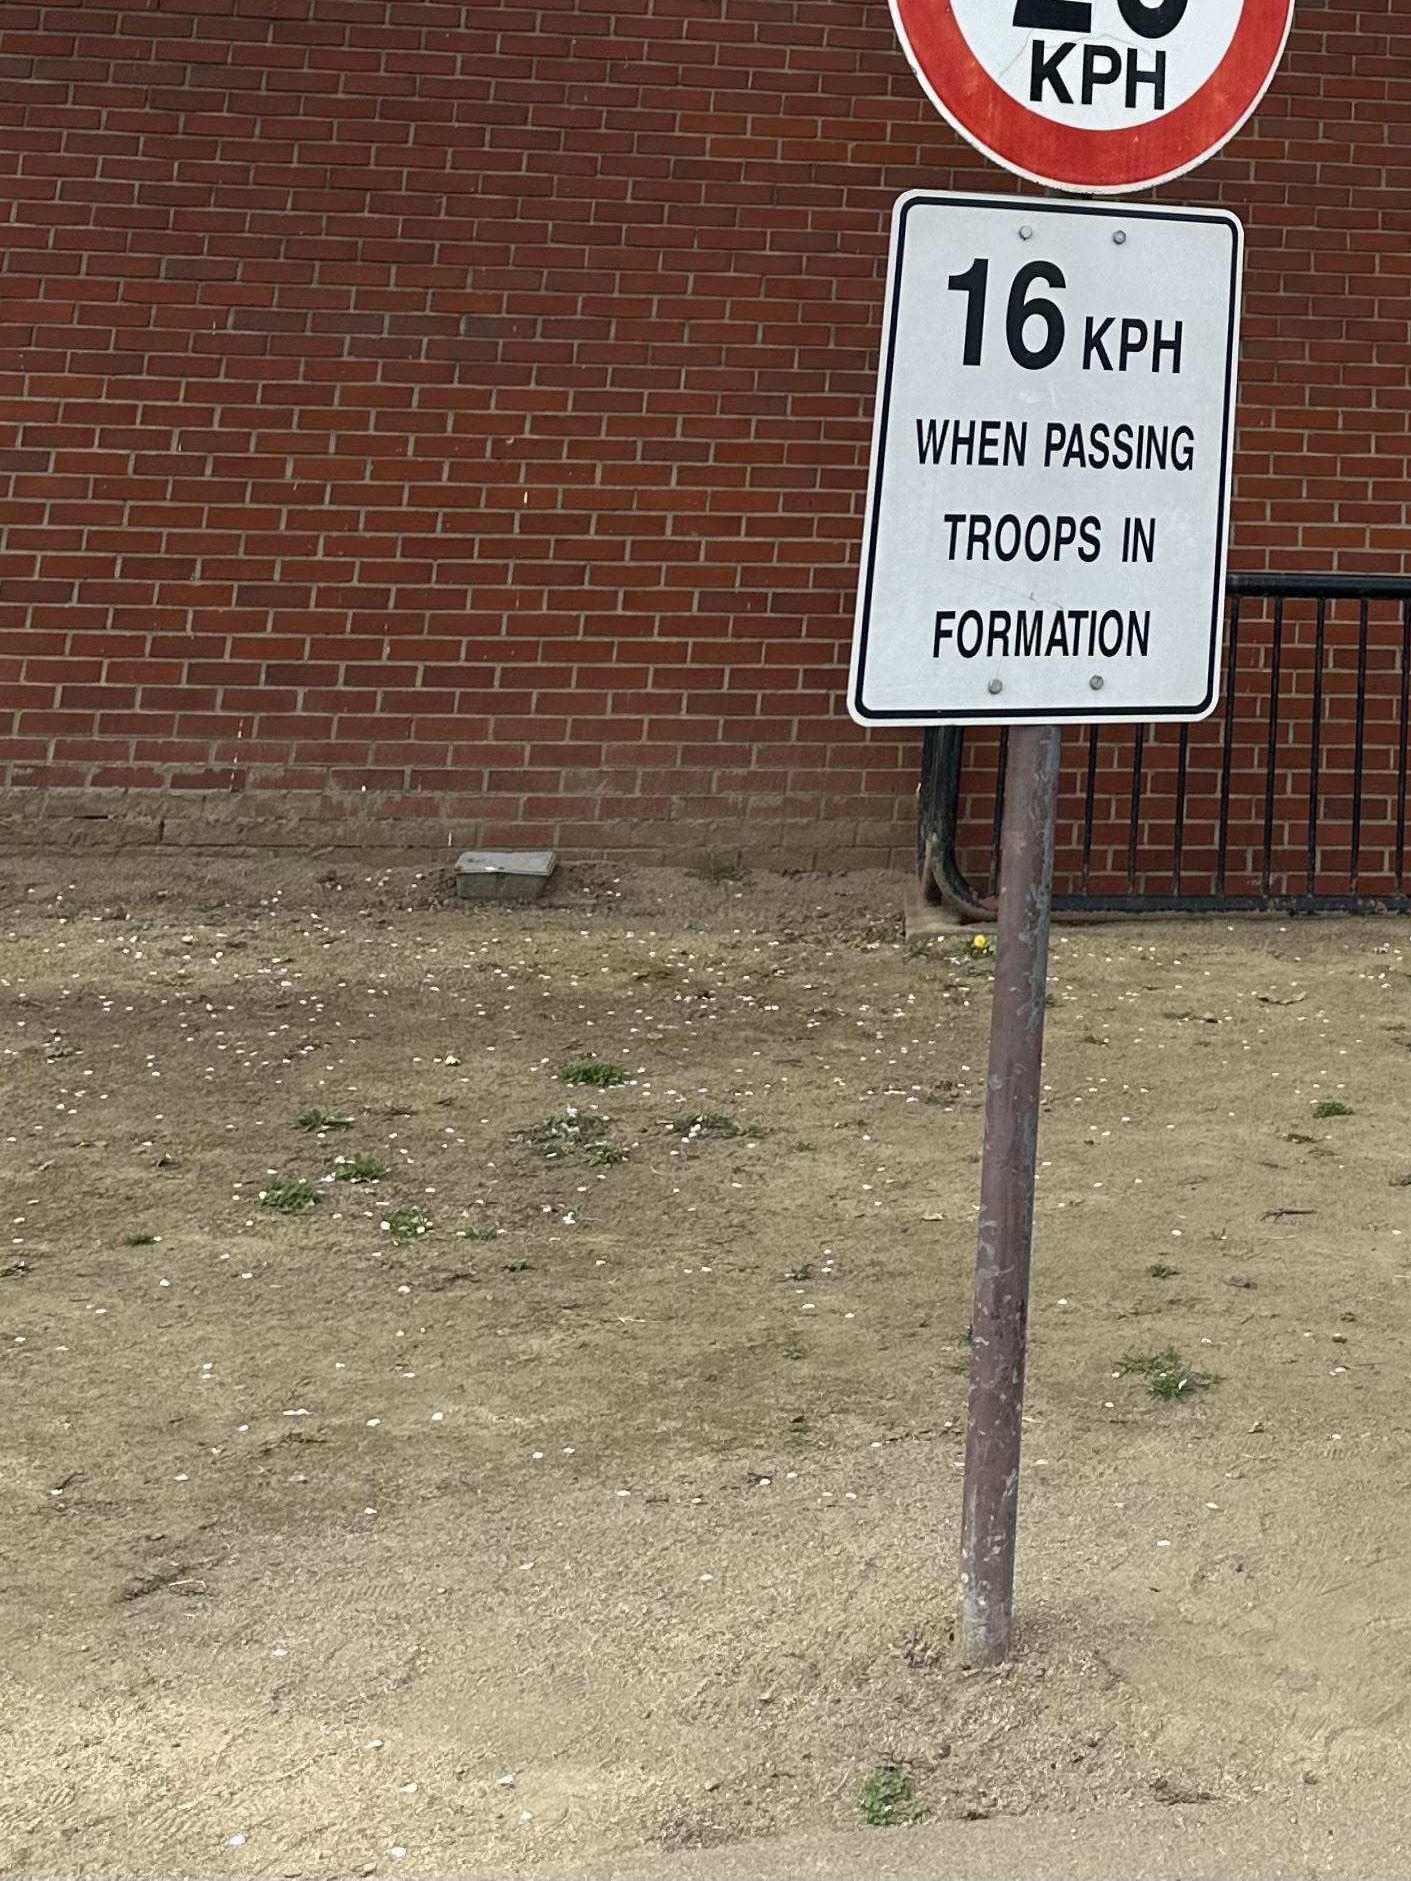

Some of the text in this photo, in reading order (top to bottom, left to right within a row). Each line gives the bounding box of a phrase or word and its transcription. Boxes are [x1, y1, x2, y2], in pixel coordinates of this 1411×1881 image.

[1029, 39, 1166, 111] KPH
[947, 258, 1183, 374] 16 KPH
[916, 418, 1195, 472] WHEN PASSING
[943, 513, 1156, 563] TROOPS IN
[932, 609, 1151, 659] FORMATION
